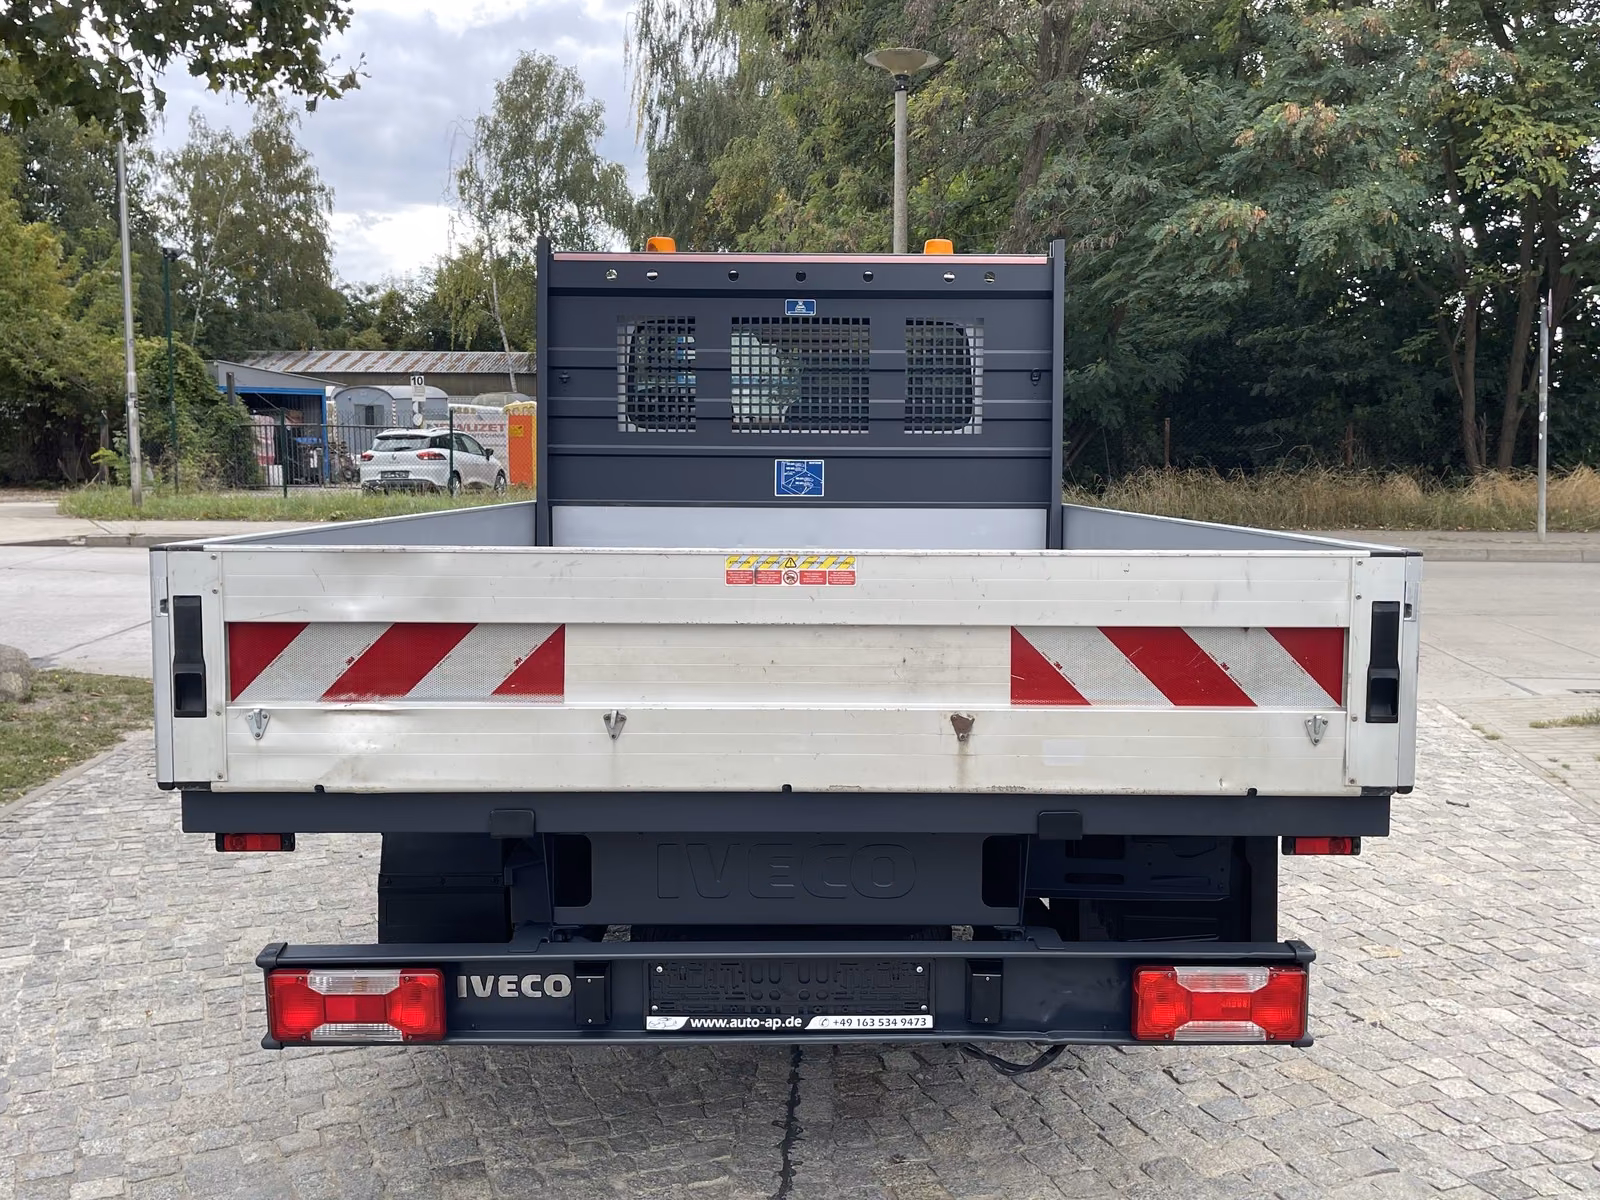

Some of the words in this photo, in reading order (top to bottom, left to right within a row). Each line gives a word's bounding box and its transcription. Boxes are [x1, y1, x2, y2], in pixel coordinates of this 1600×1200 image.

[411, 376, 424, 386] 10
[657, 843, 917, 899] IVECO
[457, 974, 572, 998] IVECO
[690, 1016, 803, 1030] www.auto-ap.de
[833, 1018, 852, 1027] +49
[857, 1018, 875, 1027] 163
[878, 1018, 898, 1027] 534
[900, 1017, 927, 1027] 9473
